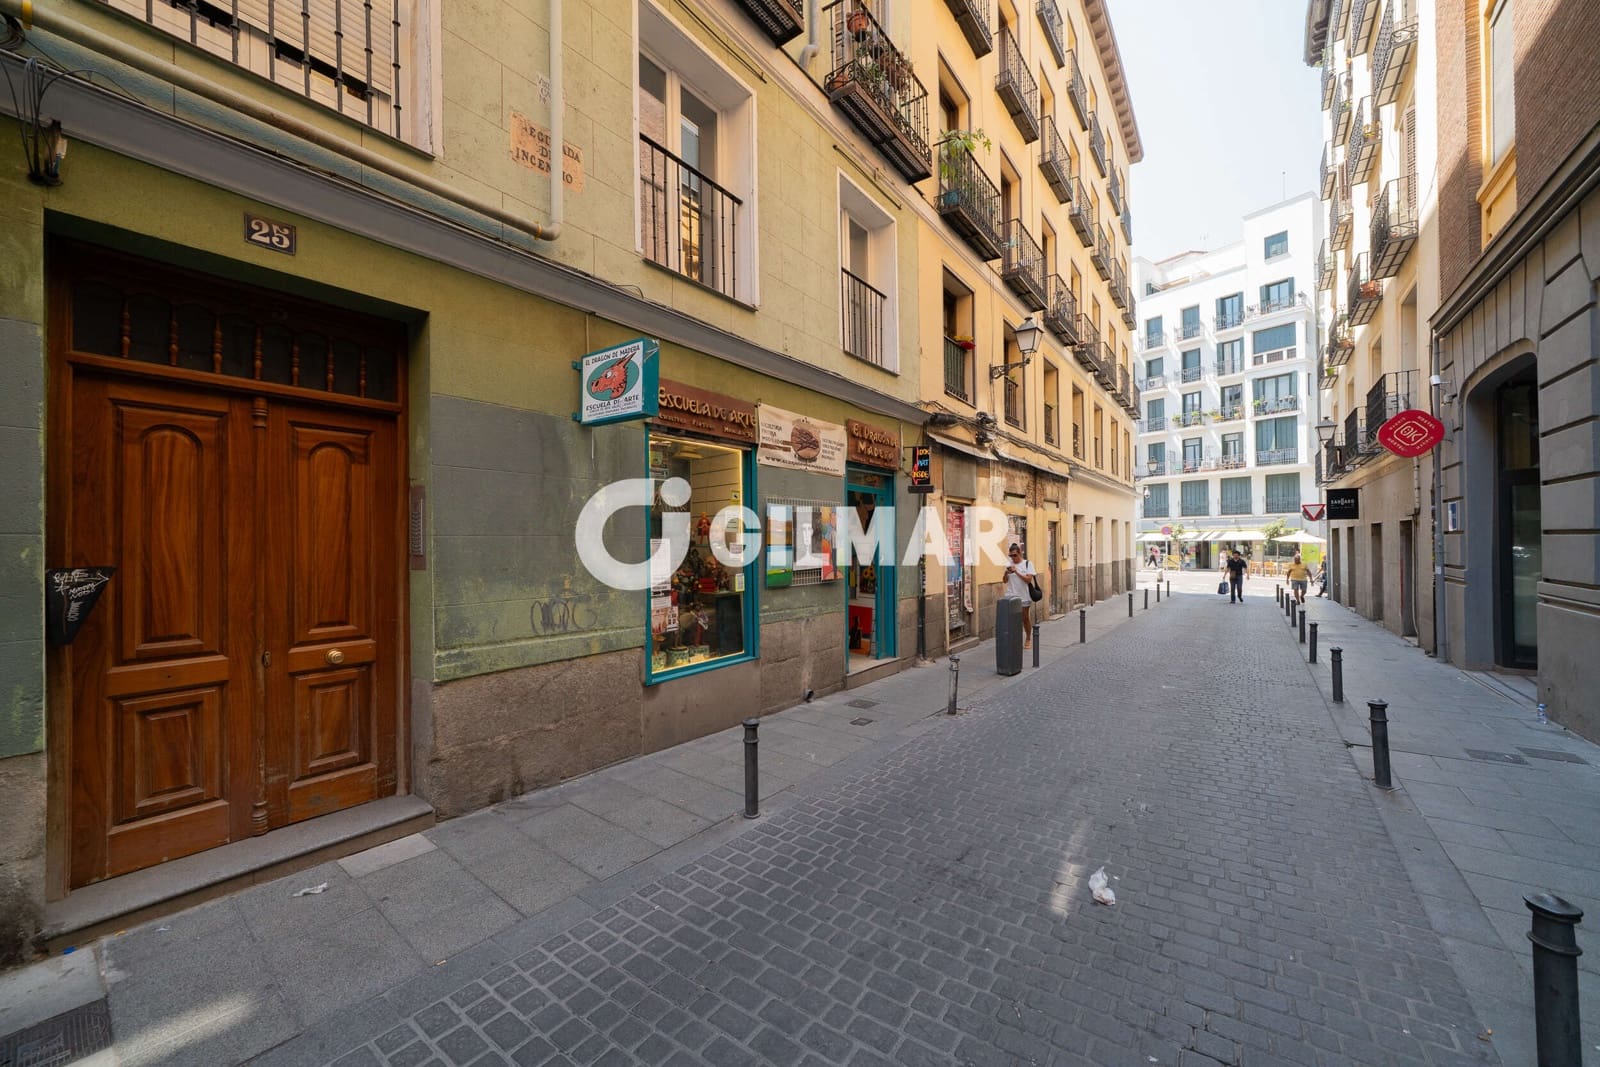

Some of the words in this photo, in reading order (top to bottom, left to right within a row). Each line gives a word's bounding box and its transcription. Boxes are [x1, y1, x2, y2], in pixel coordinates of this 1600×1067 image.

[515, 147, 573, 184] INCENIO
[251, 219, 290, 249] 25
[611, 350, 618, 358] DE
[619, 344, 641, 355] MADERA
[586, 400, 611, 411] ESCUELA
[624, 394, 640, 402] ARTE
[658, 386, 712, 417] ESCUELA
[713, 405, 727, 420] DE
[730, 409, 756, 428] ARTE
